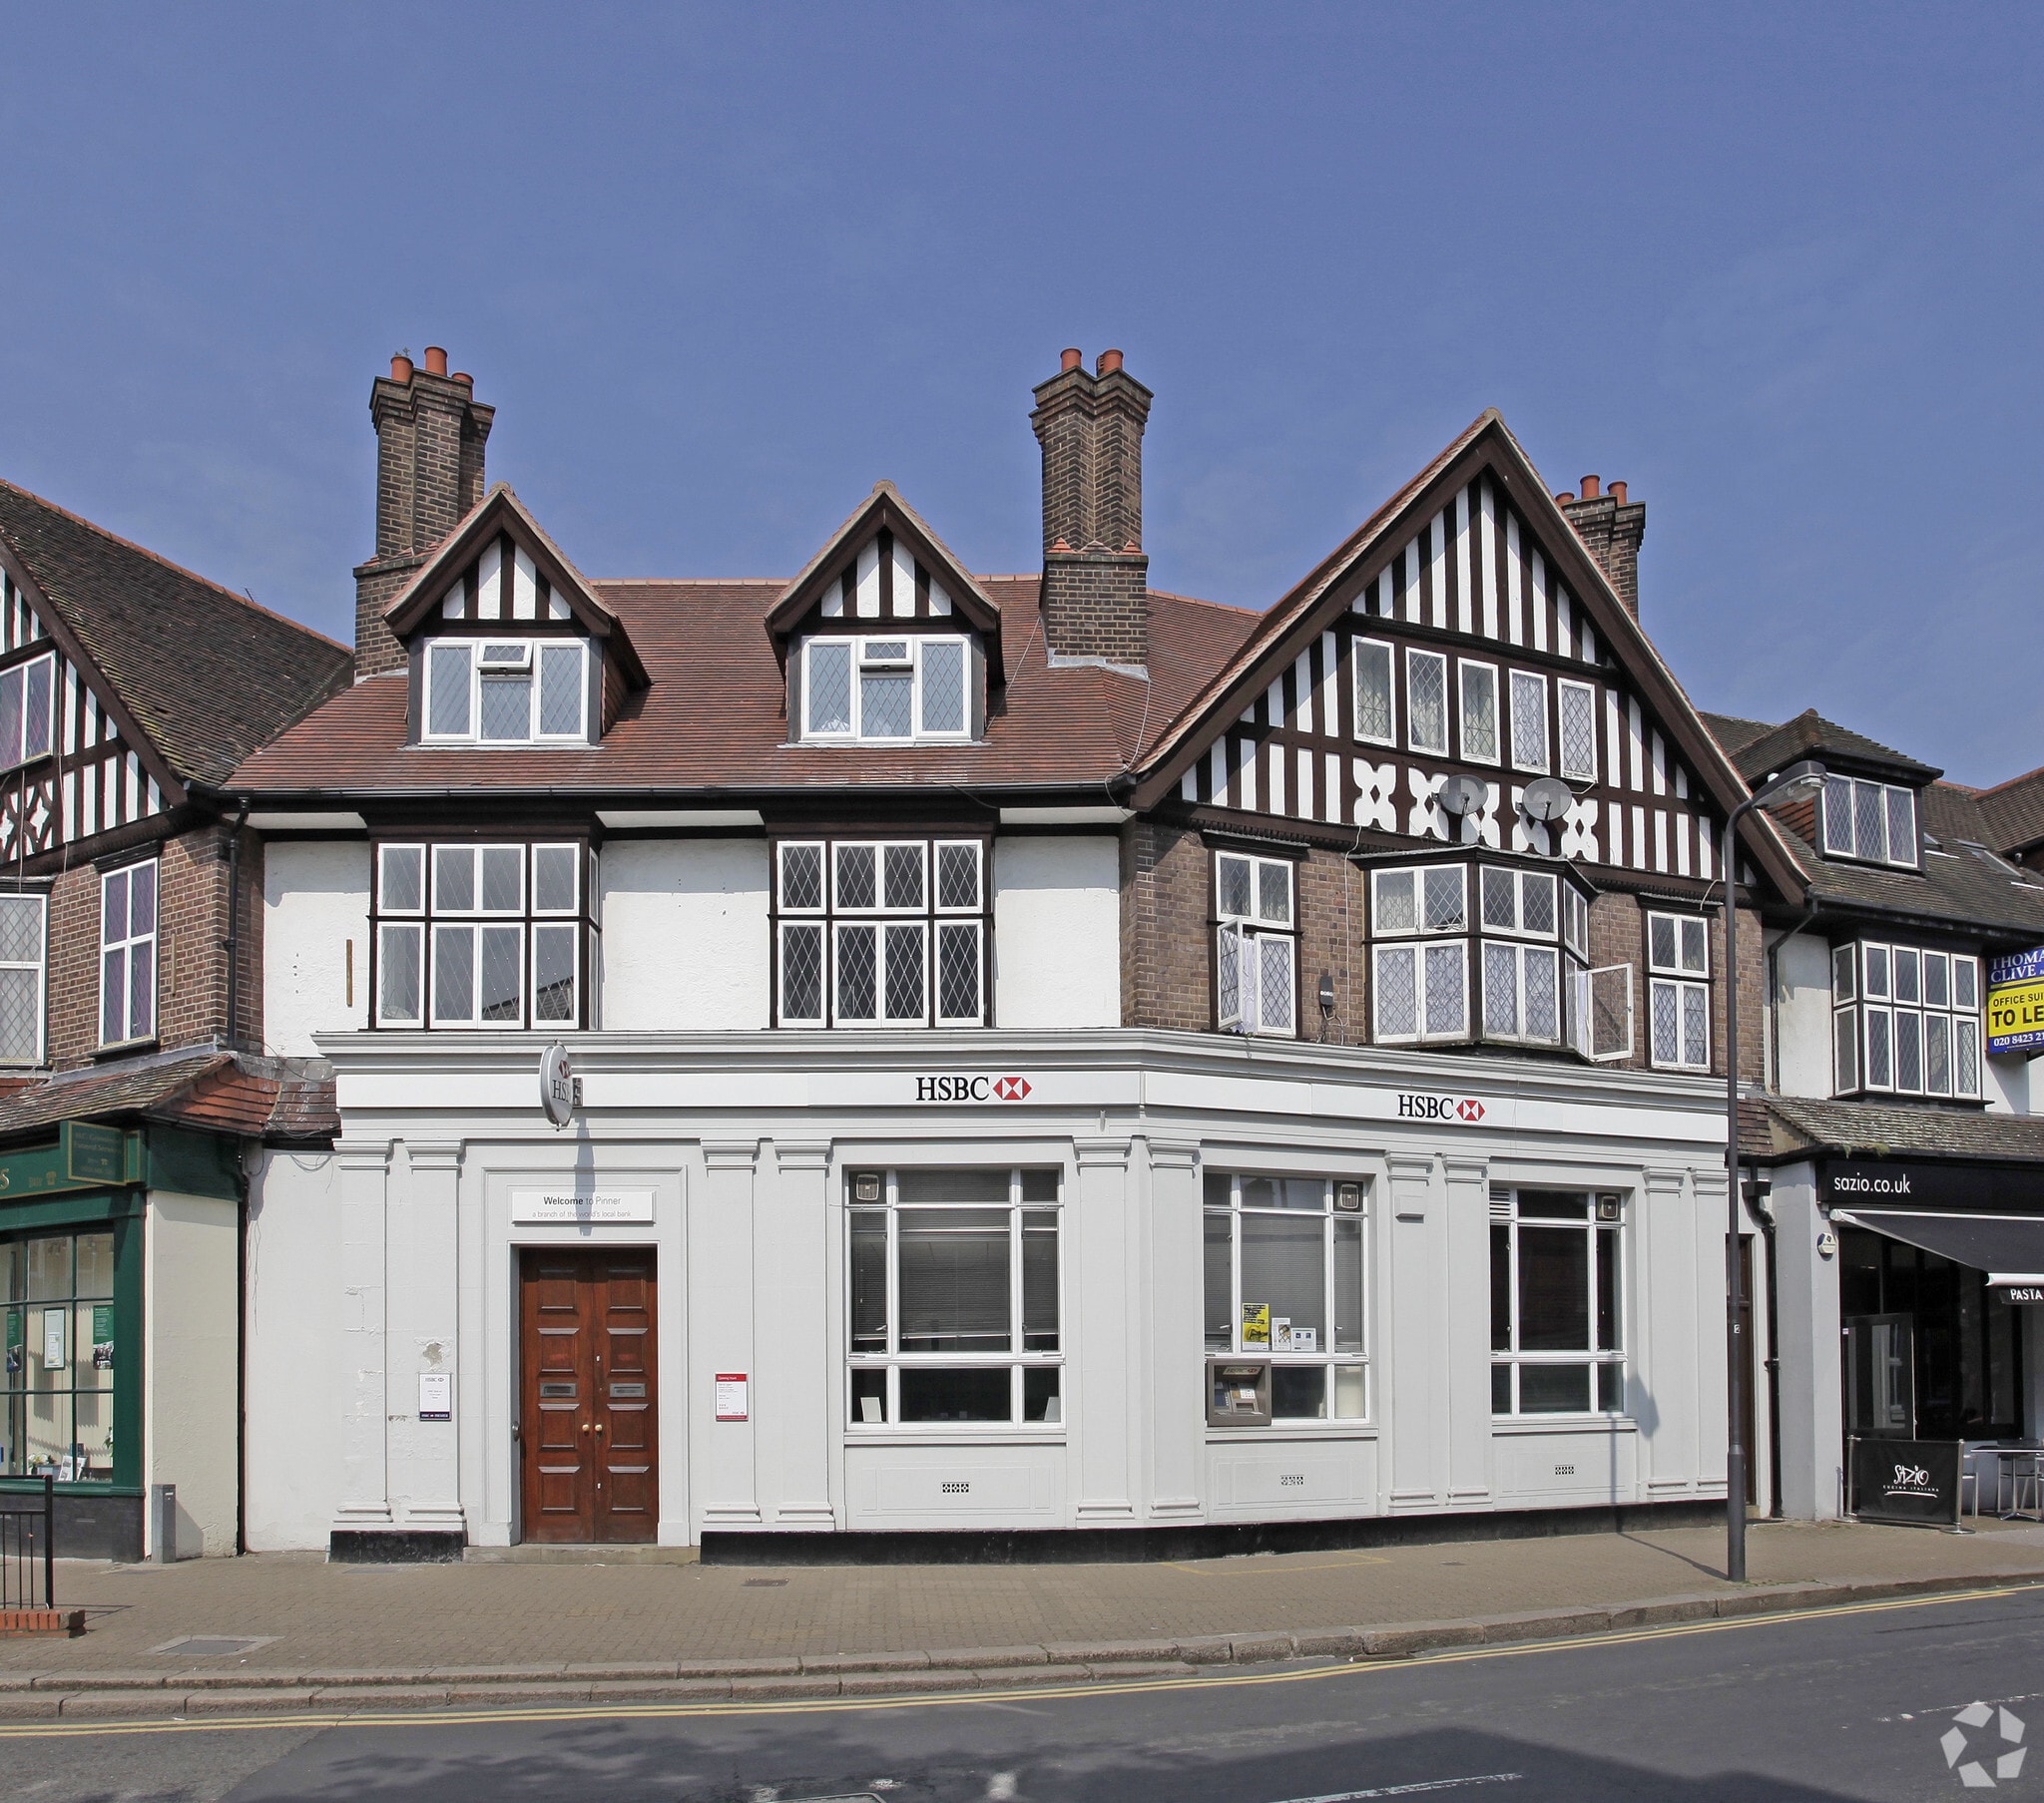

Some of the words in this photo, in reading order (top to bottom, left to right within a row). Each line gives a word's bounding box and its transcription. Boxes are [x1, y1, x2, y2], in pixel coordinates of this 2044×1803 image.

[1991, 965, 2036, 983] CLIVE
[1993, 994, 2025, 1007] OFFICE
[1992, 1009, 2016, 1028] TO
[2022, 1005, 2044, 1024] LE
[1994, 1037, 2010, 1047] 020
[2012, 1034, 2033, 1044] 8423
[915, 1076, 990, 1101] HSBC
[1397, 1094, 1454, 1120] HSBC
[1834, 1171, 1911, 1193] sazio.co.uk
[543, 1196, 584, 1205] Welcome
[585, 1196, 594, 1205] to
[595, 1195, 622, 1205] Pinner
[2010, 1288, 2044, 1300] PASTA
